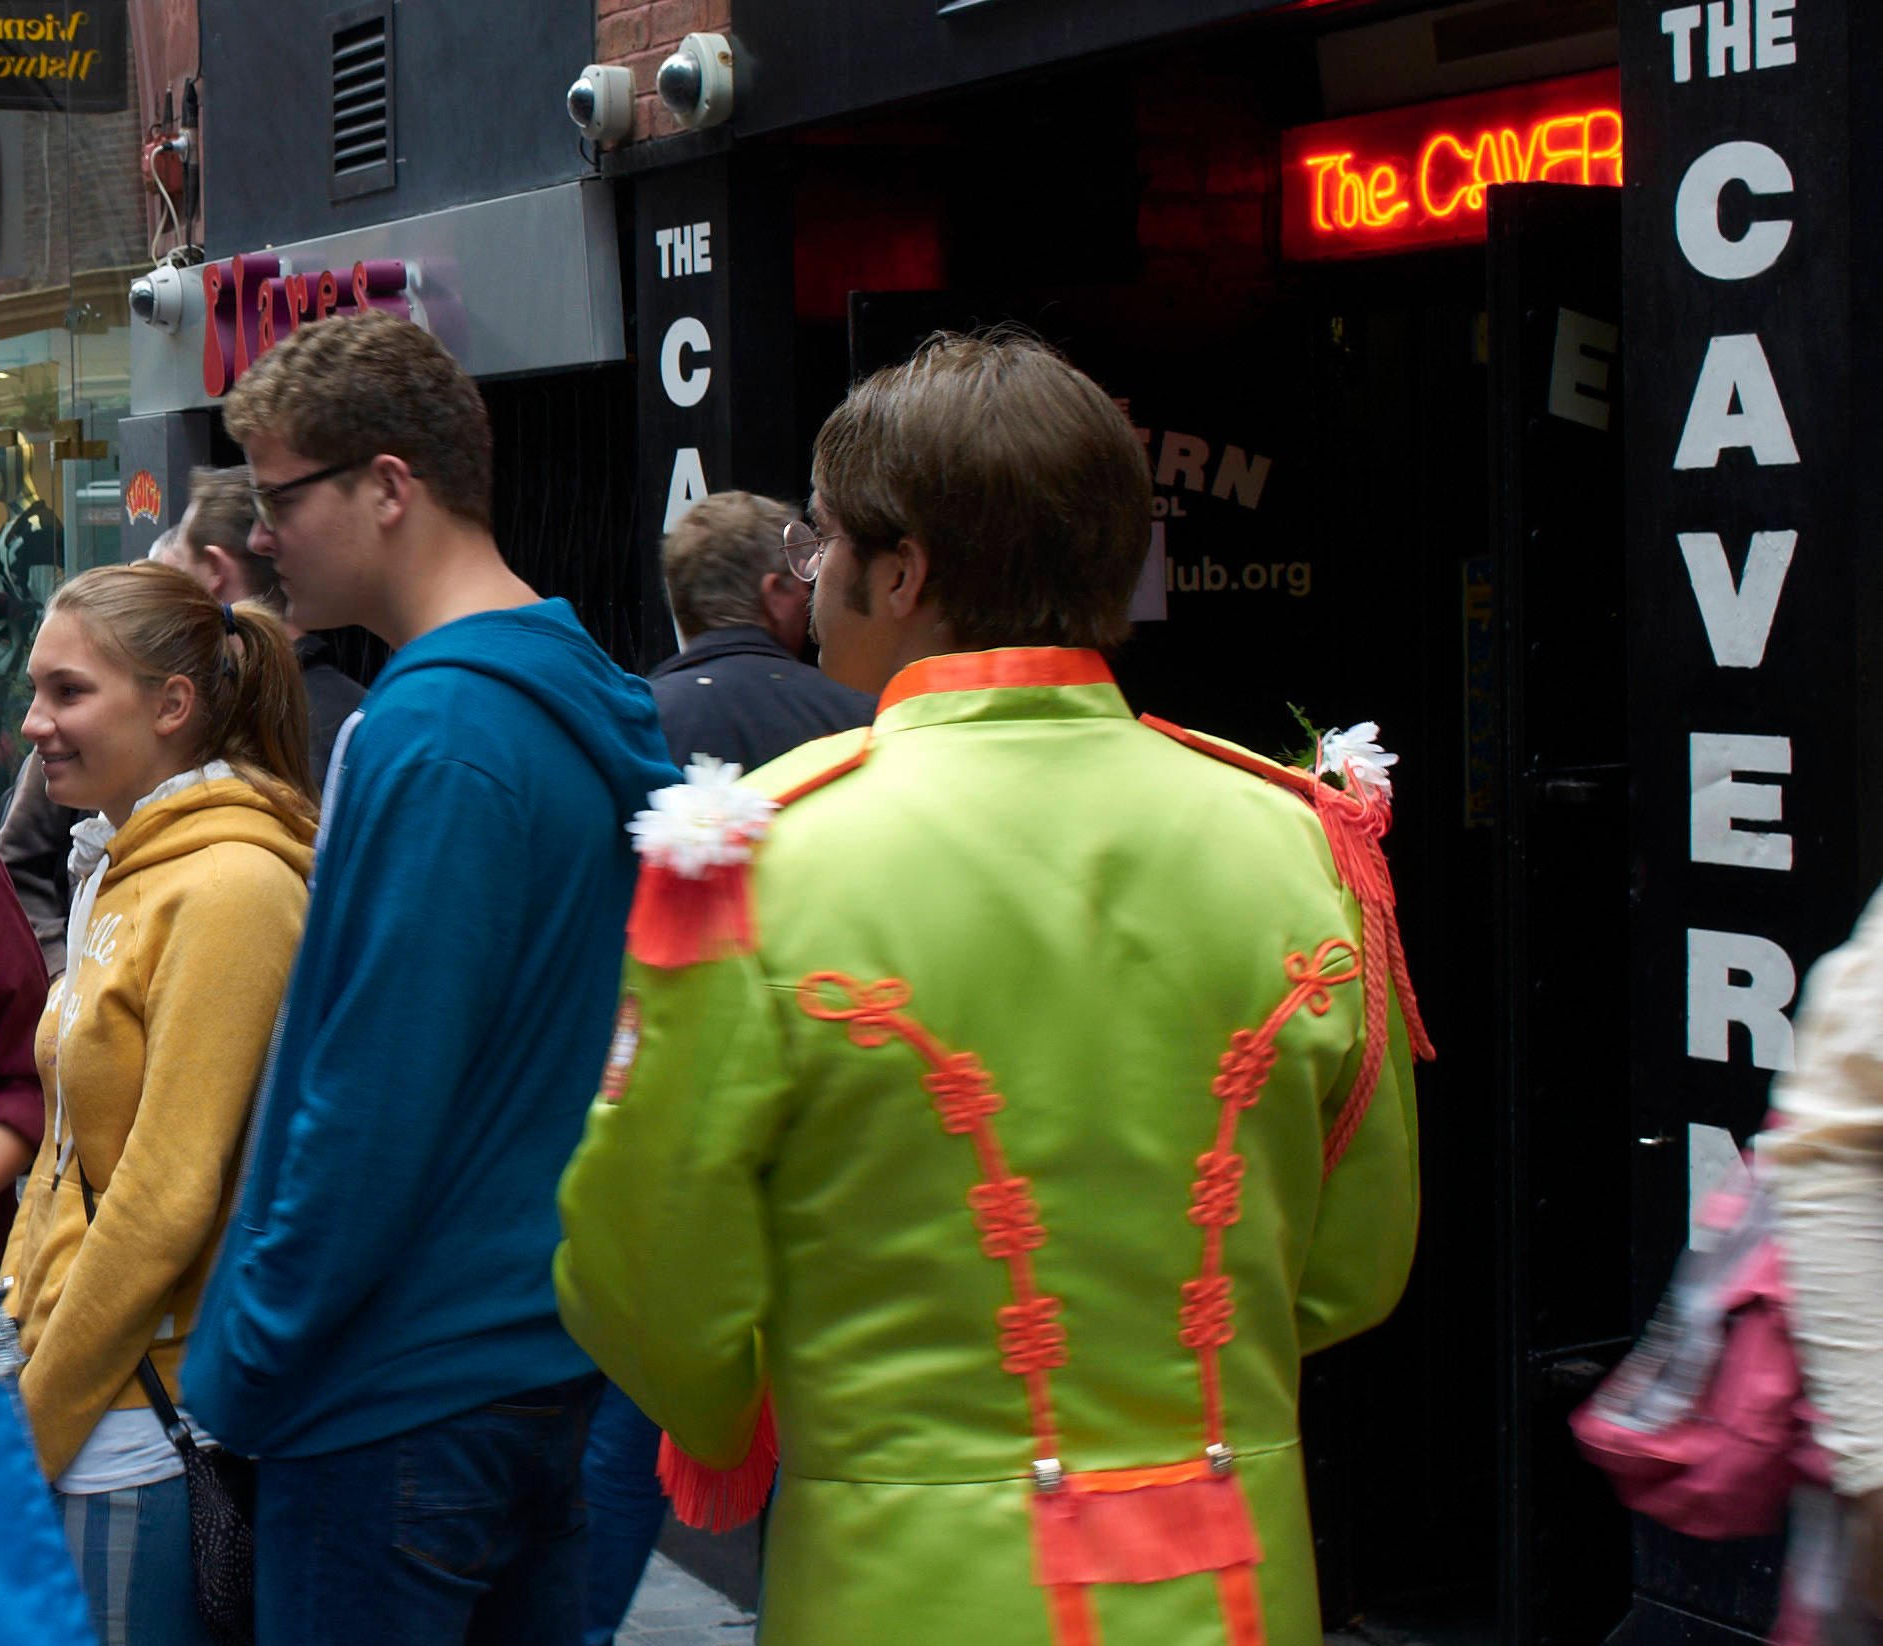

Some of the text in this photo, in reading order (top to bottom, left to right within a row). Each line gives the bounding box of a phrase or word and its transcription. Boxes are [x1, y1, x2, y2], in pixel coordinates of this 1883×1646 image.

[1661, 0, 1798, 83] THE
[1306, 152, 1409, 232] The
[656, 222, 712, 279] THE
